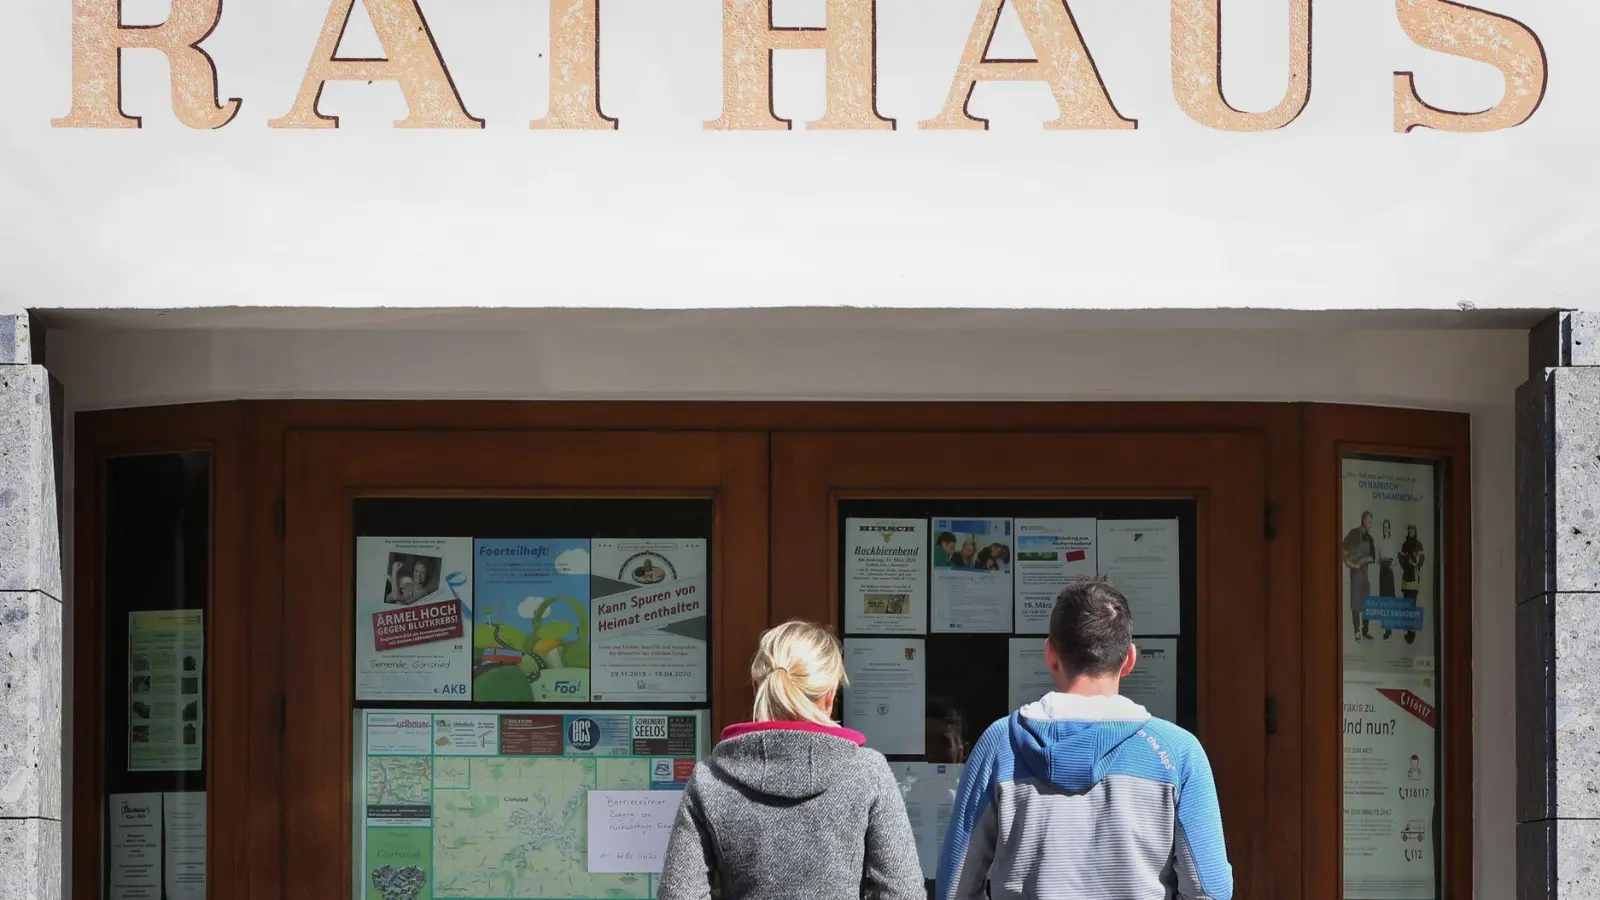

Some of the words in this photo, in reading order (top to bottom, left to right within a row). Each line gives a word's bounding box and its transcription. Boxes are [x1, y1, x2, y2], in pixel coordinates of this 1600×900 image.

[50, 0, 1548, 133] RATHAUS
[858, 525, 915, 533] HIRSCH
[854, 546, 920, 557] Bockbierabend
[598, 600, 627, 616] Kann
[630, 591, 671, 609] Spuren
[675, 585, 696, 597] von
[376, 612, 419, 627] ÄRMEL
[421, 604, 457, 619] HOCH
[598, 613, 641, 632] Heimat
[644, 601, 700, 621] enthalten
[377, 625, 406, 636] GEGEN
[408, 615, 459, 630] BLUTKREBS!
[442, 684, 467, 695] AKB
[554, 680, 581, 694] Foo!
[1344, 702, 1363, 713] raxis
[1364, 703, 1377, 713] zu.
[1406, 695, 1431, 717] 116117
[635, 717, 666, 725] SCHREINEREI
[1366, 719, 1396, 735] nun?
[634, 725, 666, 738] SEELOS
[1147, 736, 1161, 751] the
[1405, 788, 1430, 799] 116117
[1410, 850, 1422, 860] 112
